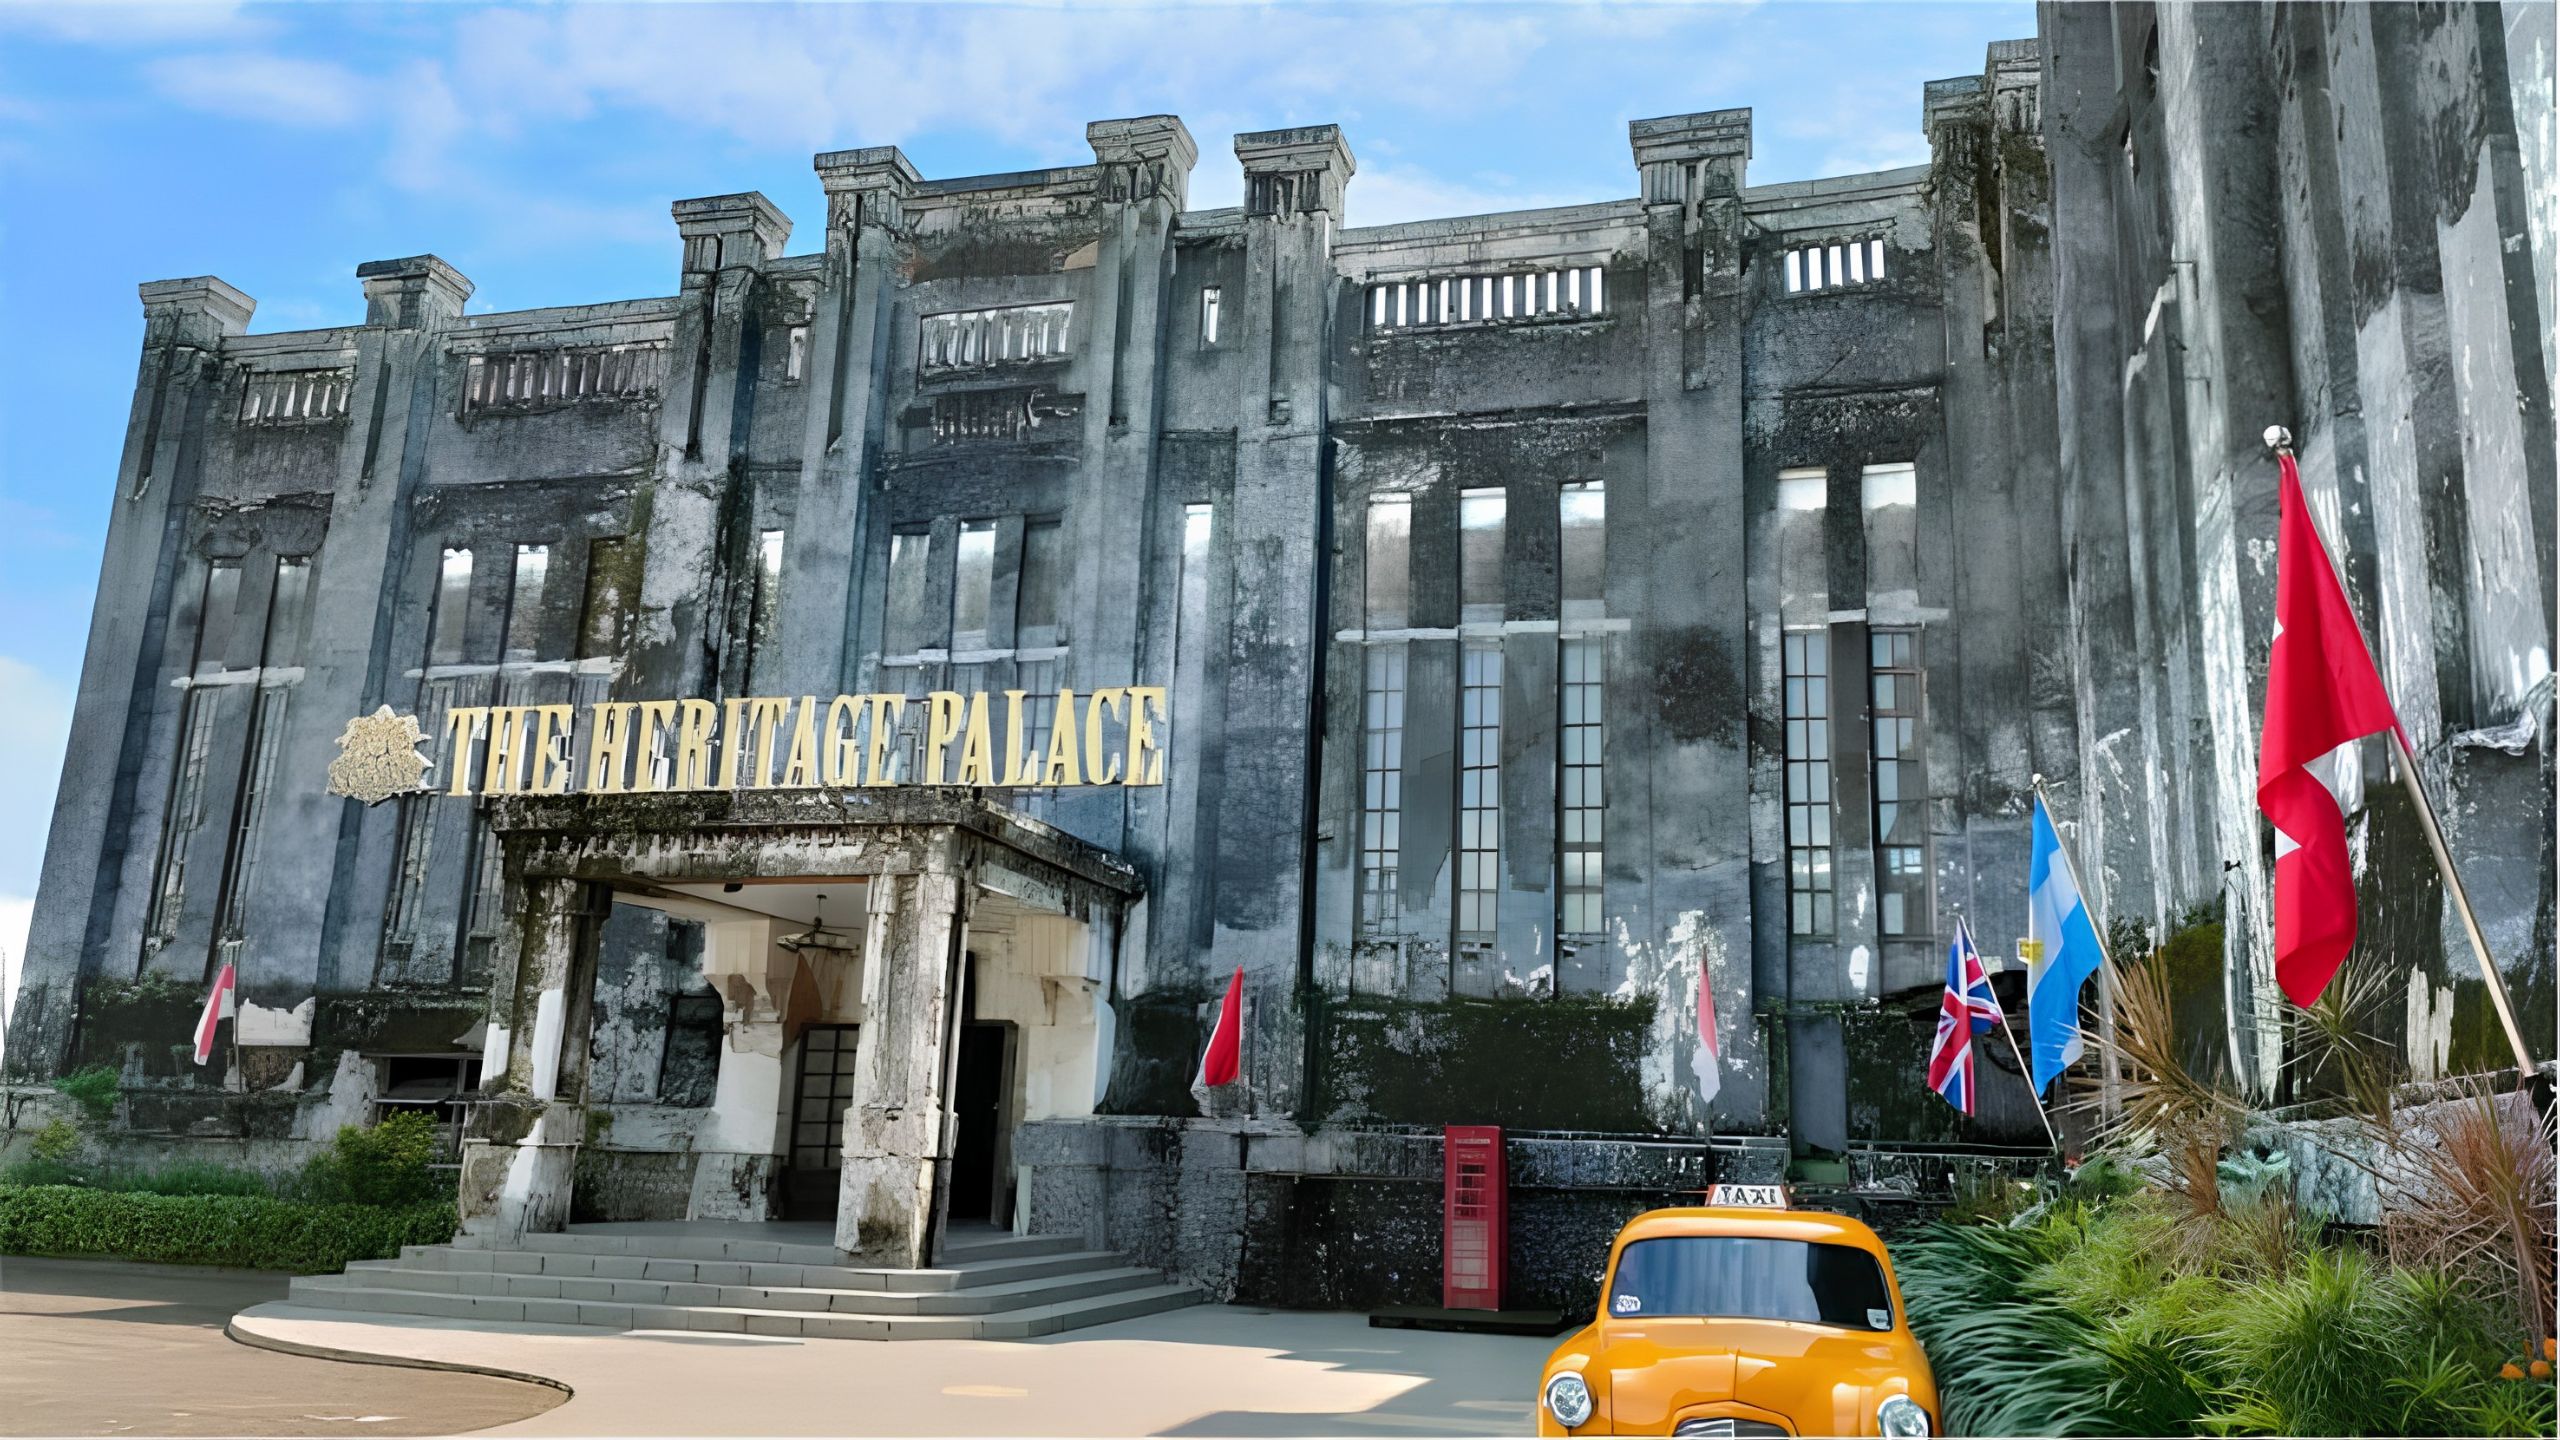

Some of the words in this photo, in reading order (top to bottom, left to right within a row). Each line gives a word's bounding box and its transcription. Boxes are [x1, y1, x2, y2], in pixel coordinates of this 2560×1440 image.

[447, 704, 574, 797] THE
[586, 693, 906, 795] HERITAGE
[922, 686, 1166, 788] PALACE
[1717, 1186, 1778, 1205] TAXI
